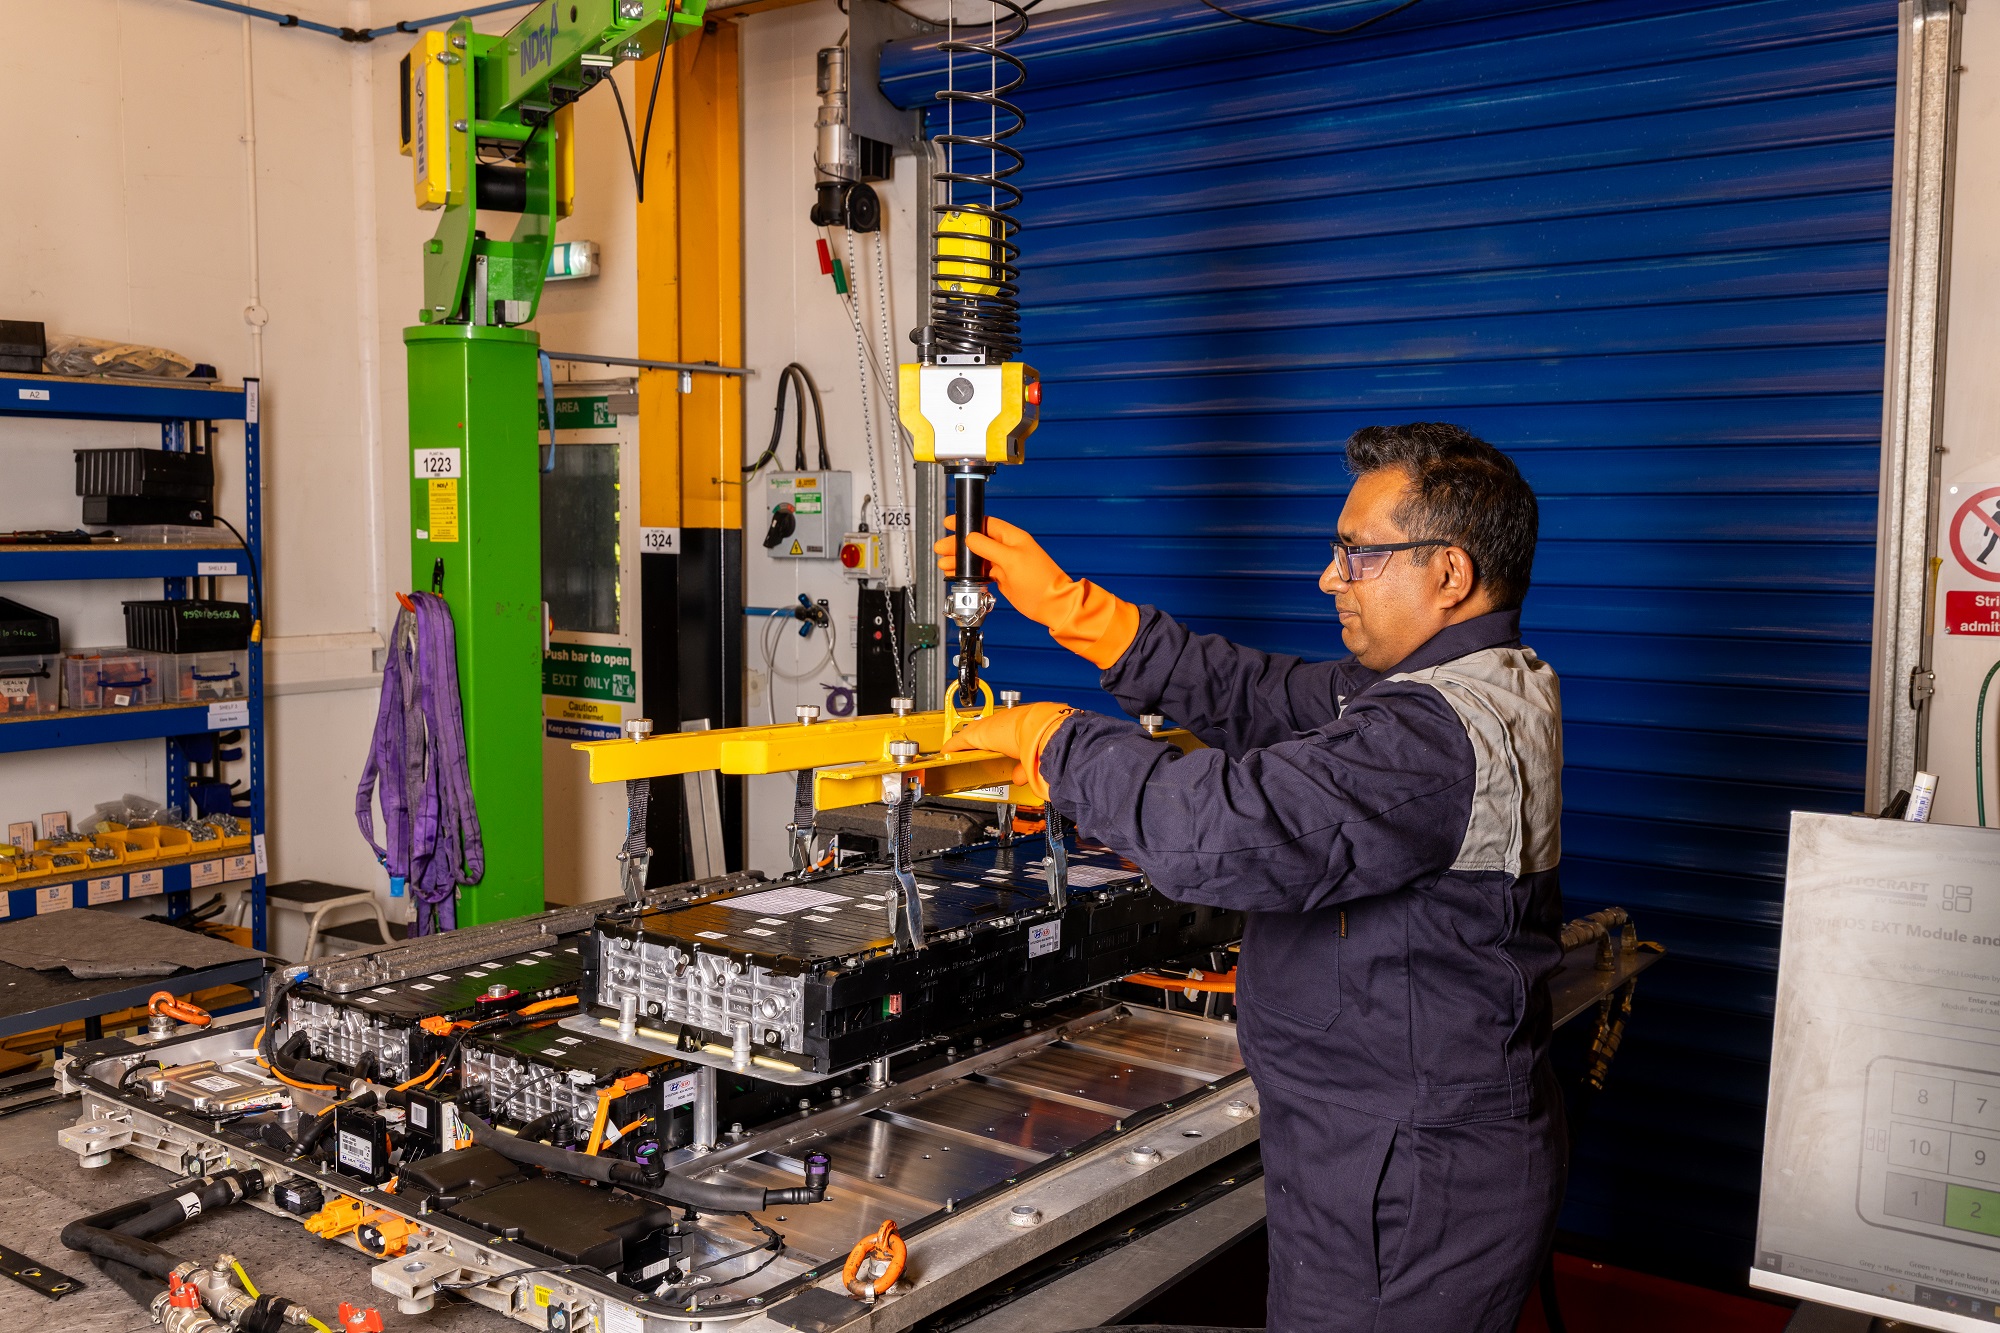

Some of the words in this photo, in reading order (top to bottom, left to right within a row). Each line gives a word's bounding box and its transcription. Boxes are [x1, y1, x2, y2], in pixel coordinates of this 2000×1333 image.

[520, 4, 559, 78] INDEVA
[415, 77, 425, 174] INDEVA
[29, 390, 40, 399] A2
[555, 401, 580, 413] AREA
[423, 456, 452, 473] 1223
[881, 511, 911, 526] 1265
[644, 532, 673, 548] 1324
[544, 649, 569, 662] Push
[571, 649, 589, 663] bar
[590, 651, 602, 664] to
[603, 654, 630, 668] open
[552, 673, 578, 687] EXIT
[583, 675, 611, 690] ONLY
[568, 700, 598, 713] Caution
[562, 710, 576, 718] Door
[582, 712, 604, 721] alarmed
[547, 723, 564, 735] Keep
[564, 725, 580, 736] clear
[580, 727, 593, 737] Fire
[592, 728, 605, 738] exit
[606, 729, 620, 740] only
[1871, 919, 1902, 935] EXT
[1905, 923, 1968, 943] Module
[1926, 967, 1941, 975] and
[1941, 968, 1959, 977] CMU
[1960, 972, 1990, 982] Lookups
[1992, 974, 2000, 984] by
[1941, 1002, 1969, 1012] Module
[1970, 1005, 1983, 1014] and
[1968, 996, 1987, 1005] Enter
[1917, 1088, 1929, 1105] 8
[1976, 1097, 1988, 1114] 7
[1908, 1137, 1931, 1156] 10
[1974, 1149, 1986, 1166] 9
[1910, 1190, 1919, 1207] 1
[1970, 1201, 1982, 1219] 2
[1800, 1265, 1814, 1276] Type
[1814, 1268, 1830, 1278] here
[1838, 1274, 1859, 1284] search
[1859, 1259, 1876, 1270] Grey
[1884, 1264, 1903, 1275] these
[1904, 1268, 1934, 1282] modules
[1935, 1275, 1953, 1286] need
[1954, 1279, 1989, 1295] removing
[1909, 1260, 1930, 1272] Green
[1939, 1267, 1966, 1279] replace
[1966, 1271, 1988, 1284] based
